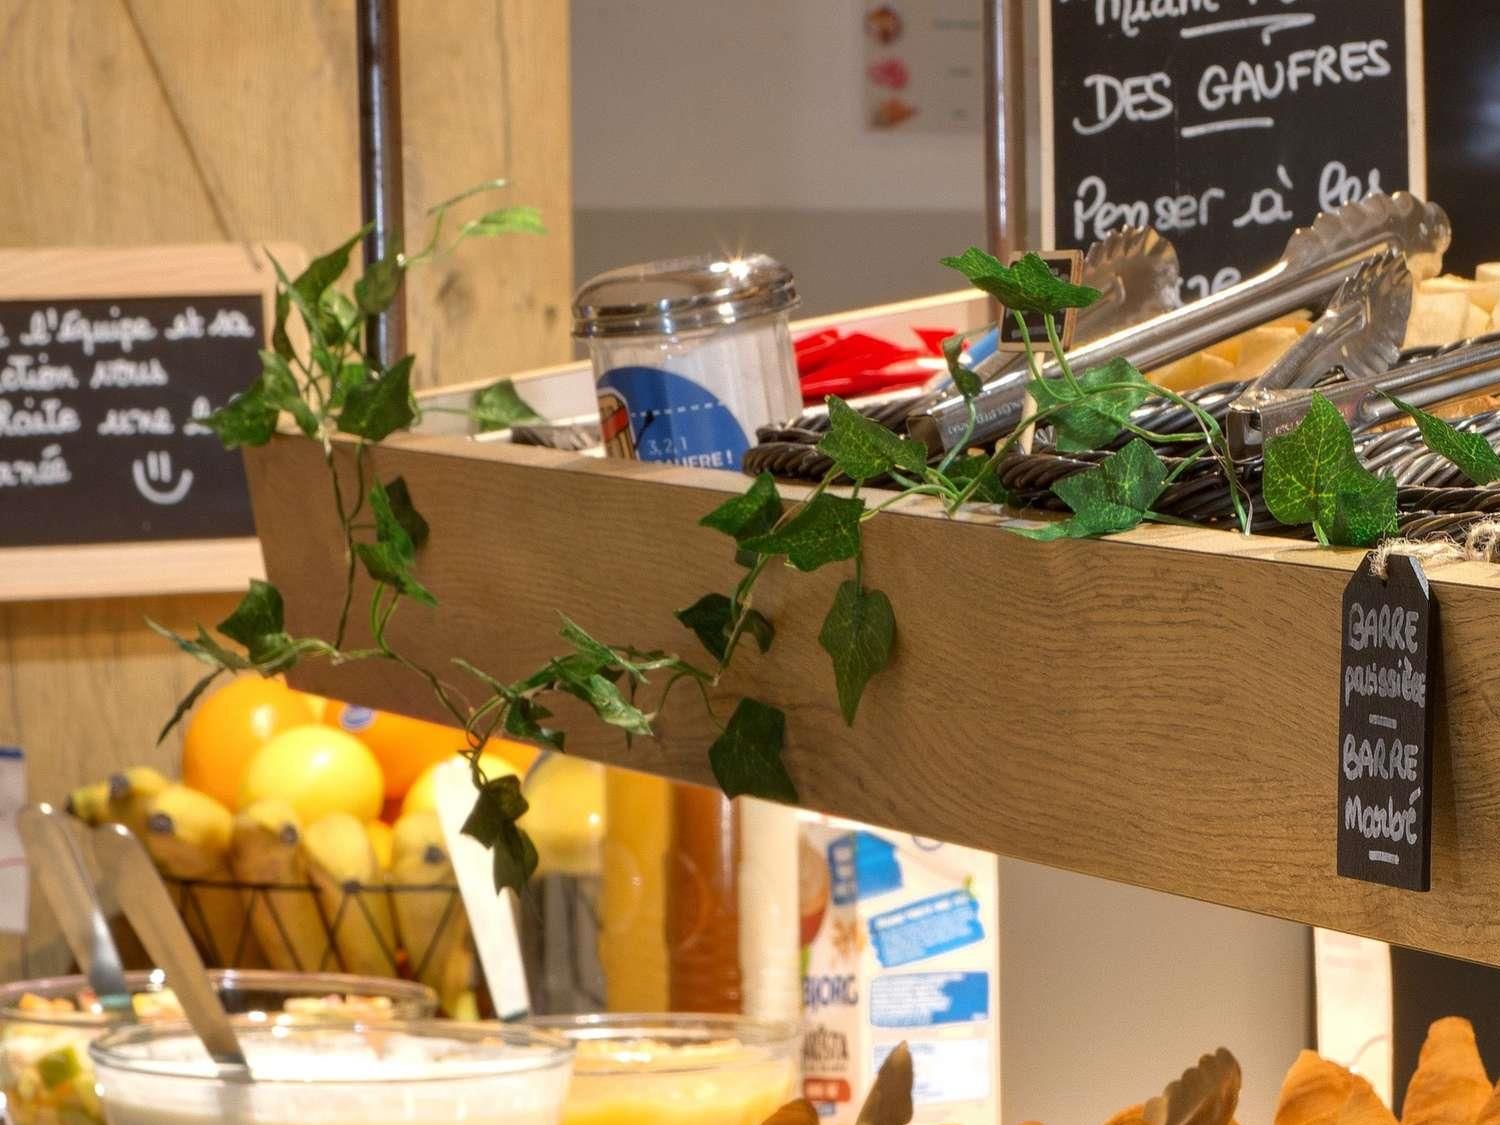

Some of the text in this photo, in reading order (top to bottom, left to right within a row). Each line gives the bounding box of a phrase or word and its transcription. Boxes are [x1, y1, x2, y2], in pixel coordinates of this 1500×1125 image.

[1072, 39, 1391, 135] DES GAUFRES
[1073, 175, 1225, 240] Penser
[1232, 164, 1293, 228] à
[1350, 602, 1419, 653] BARRE
[1343, 734, 1418, 781] BARRE
